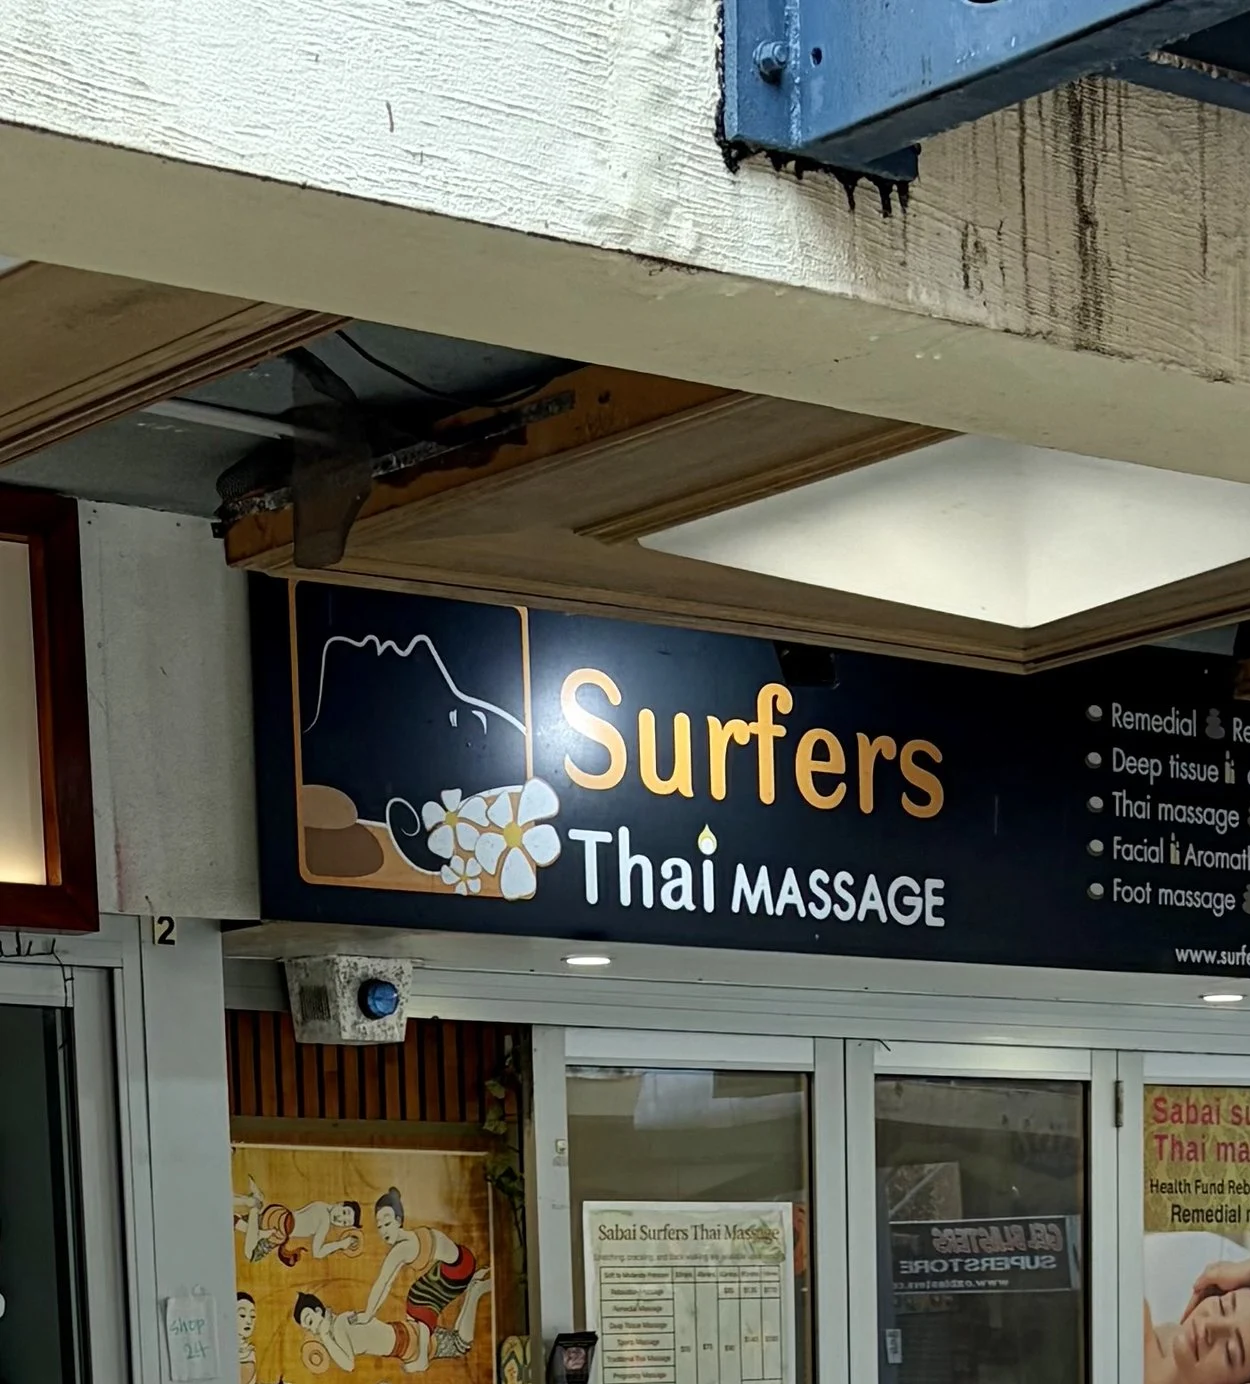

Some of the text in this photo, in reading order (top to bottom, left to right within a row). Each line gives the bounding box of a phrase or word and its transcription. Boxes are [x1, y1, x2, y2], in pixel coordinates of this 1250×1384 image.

[1112, 703, 1197, 737] Remedial
[560, 667, 944, 818] Surfers
[1112, 747, 1162, 785] Deep
[1169, 754, 1219, 783] tissue
[1112, 791, 1151, 820] Thai
[1158, 801, 1240, 834] massage
[1112, 836, 1164, 864] Facial
[568, 824, 945, 927] Thai MASSAGE
[1112, 878, 1151, 903] Foot
[1158, 886, 1236, 917] massage
[157, 914, 176, 946] 2
[1153, 1096, 1221, 1126] Sabai
[1154, 1134, 1207, 1163] Thai
[1150, 1179, 1191, 1194] Health
[1194, 1180, 1225, 1195] Fund
[1171, 1204, 1241, 1224] Remedial
[598, 1223, 780, 1245] Sabai Surfers Thai Massage
